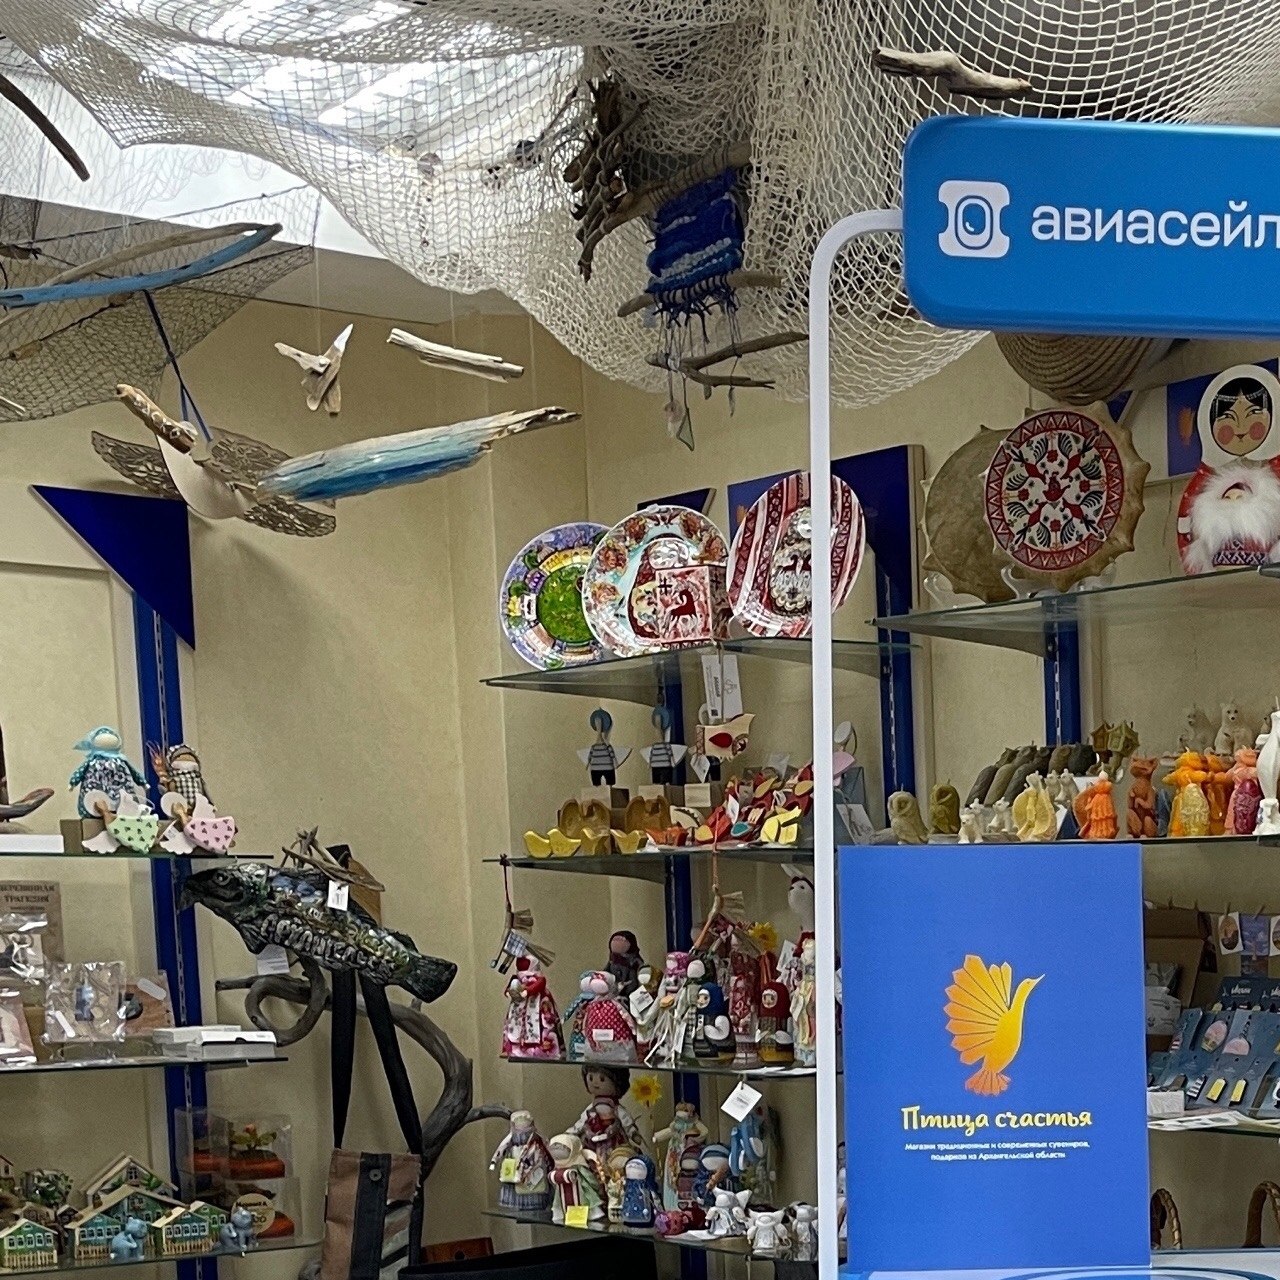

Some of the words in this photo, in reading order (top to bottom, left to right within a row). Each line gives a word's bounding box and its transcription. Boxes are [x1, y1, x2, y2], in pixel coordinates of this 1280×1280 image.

[901, 1105, 989, 1136] Птица
[995, 1111, 1092, 1130] счастья
[905, 1143, 936, 1151] Магазин
[1035, 1150, 1066, 1159] области
